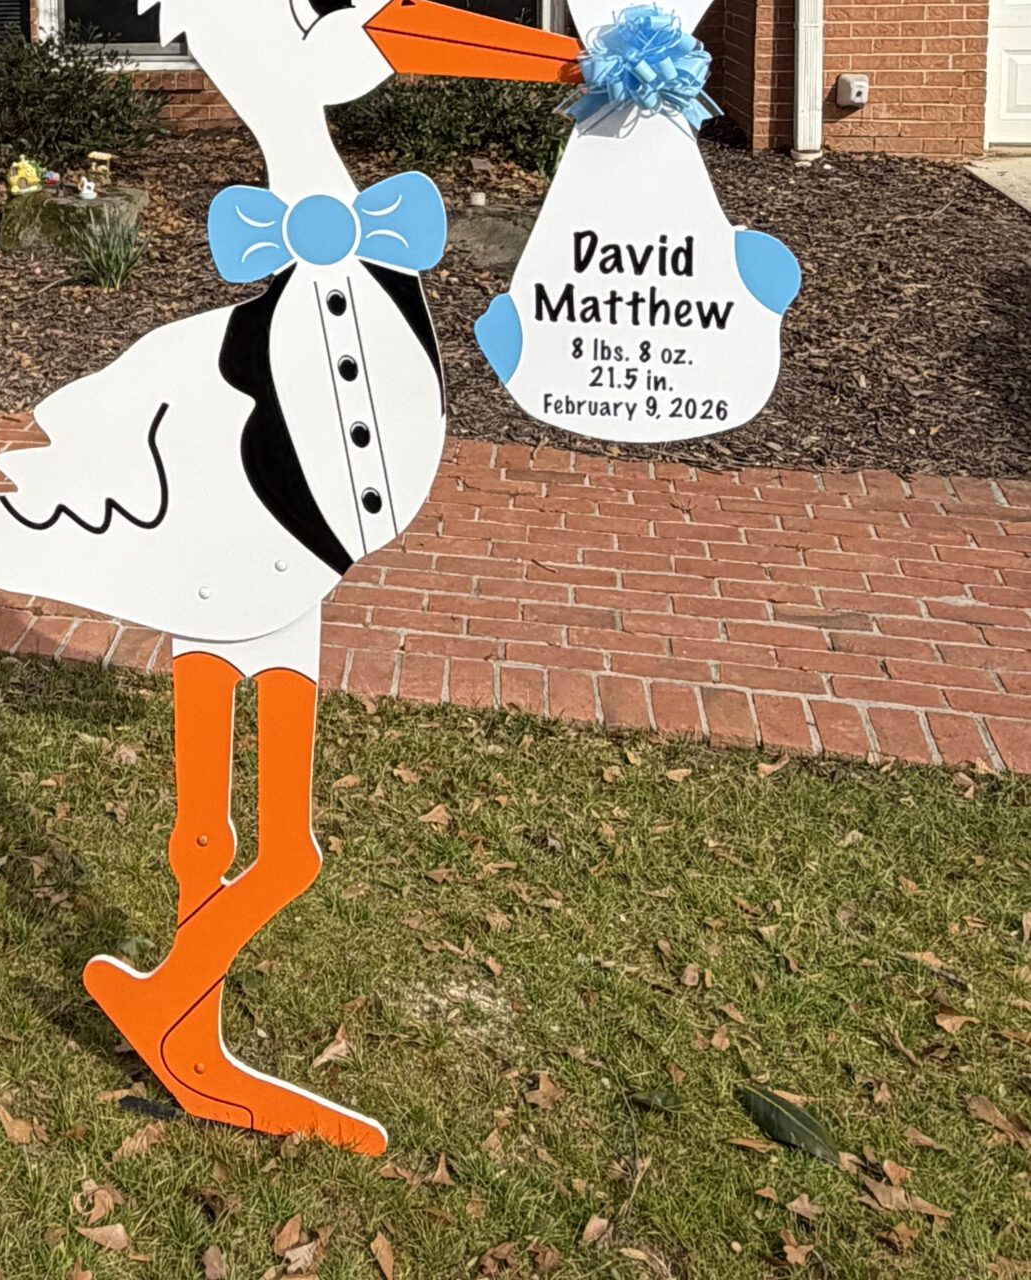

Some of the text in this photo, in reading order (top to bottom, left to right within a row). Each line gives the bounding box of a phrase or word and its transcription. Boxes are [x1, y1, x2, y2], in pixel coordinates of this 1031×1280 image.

[573, 229, 694, 277] David
[534, 282, 735, 330] Matthew
[571, 336, 693, 365] 8 lbs. 8 oz.
[588, 365, 673, 392] 21.5 in.
[543, 393, 728, 422] February 9, 2026
